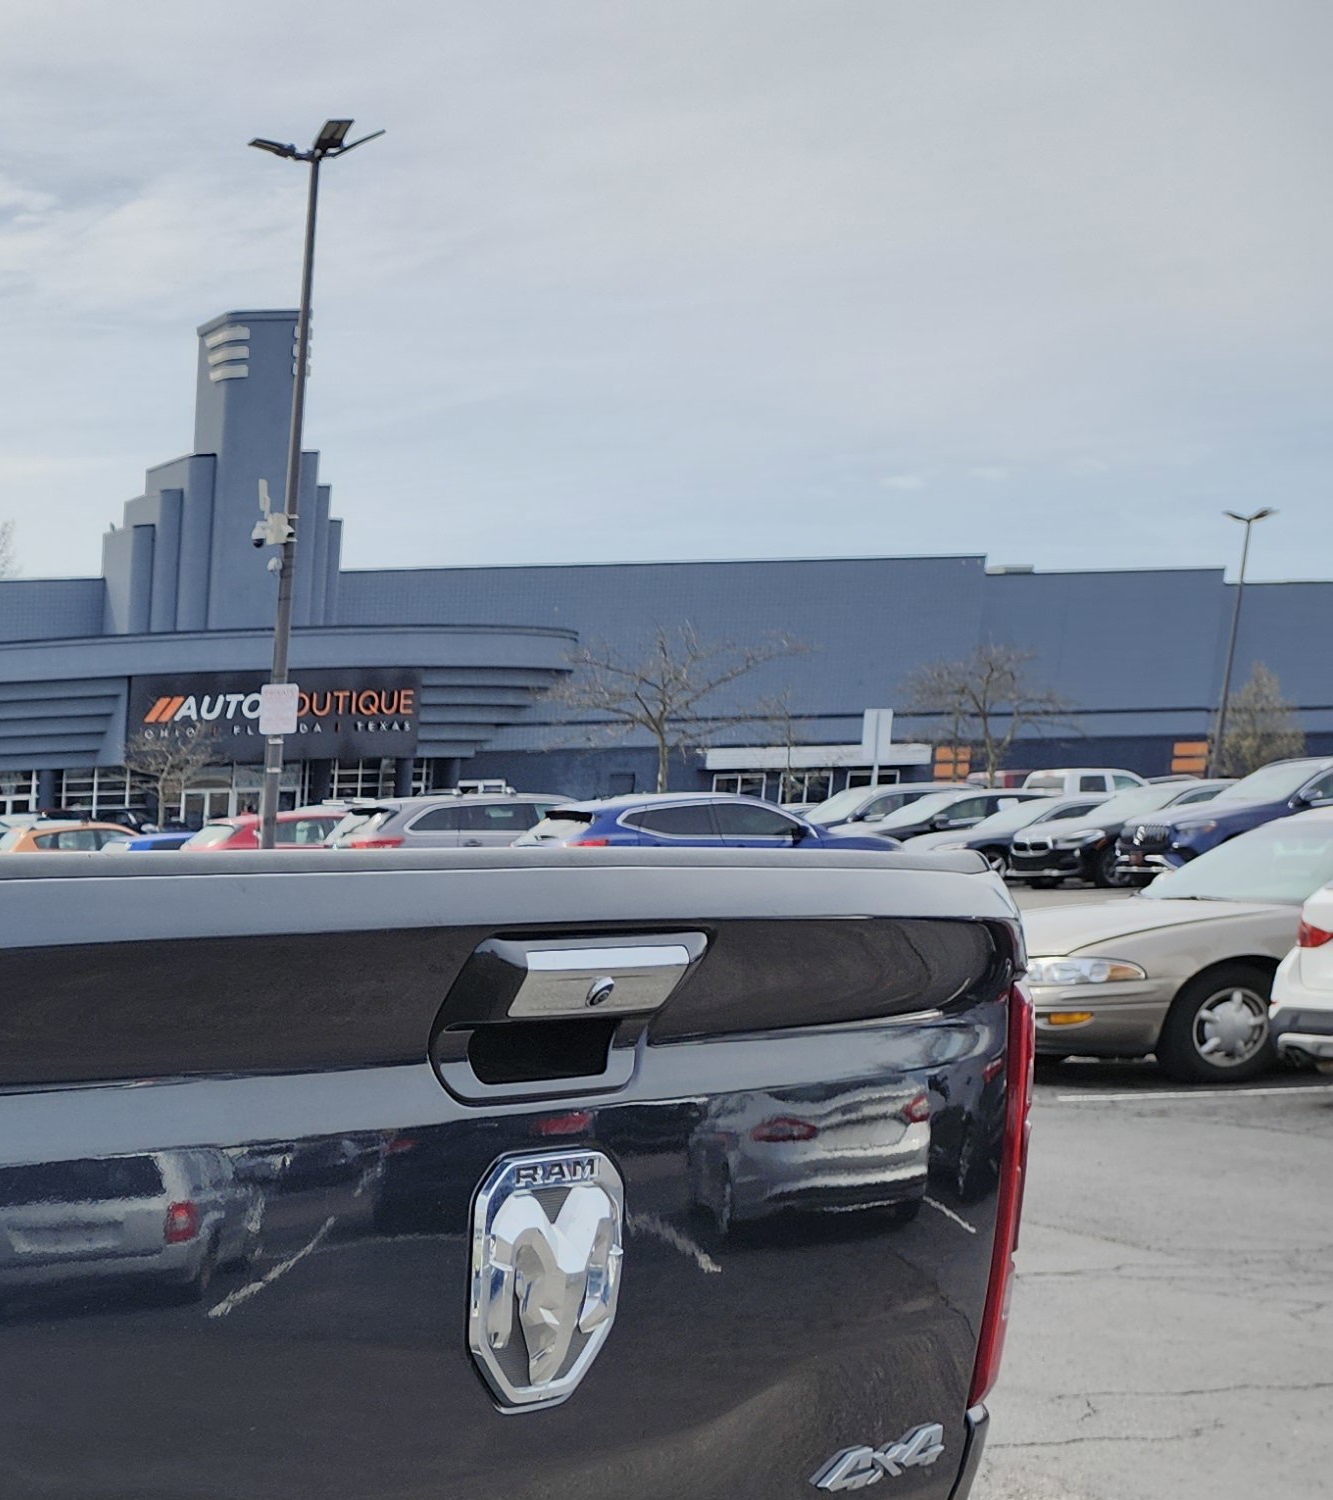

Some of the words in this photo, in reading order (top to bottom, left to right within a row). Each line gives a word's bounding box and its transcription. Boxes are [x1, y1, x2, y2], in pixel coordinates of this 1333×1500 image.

[174, 689, 414, 721] AUTOUTIQUE
[233, 722, 322, 736] FLDA
[356, 721, 412, 733] TEXAS
[514, 1158, 600, 1188] RAM
